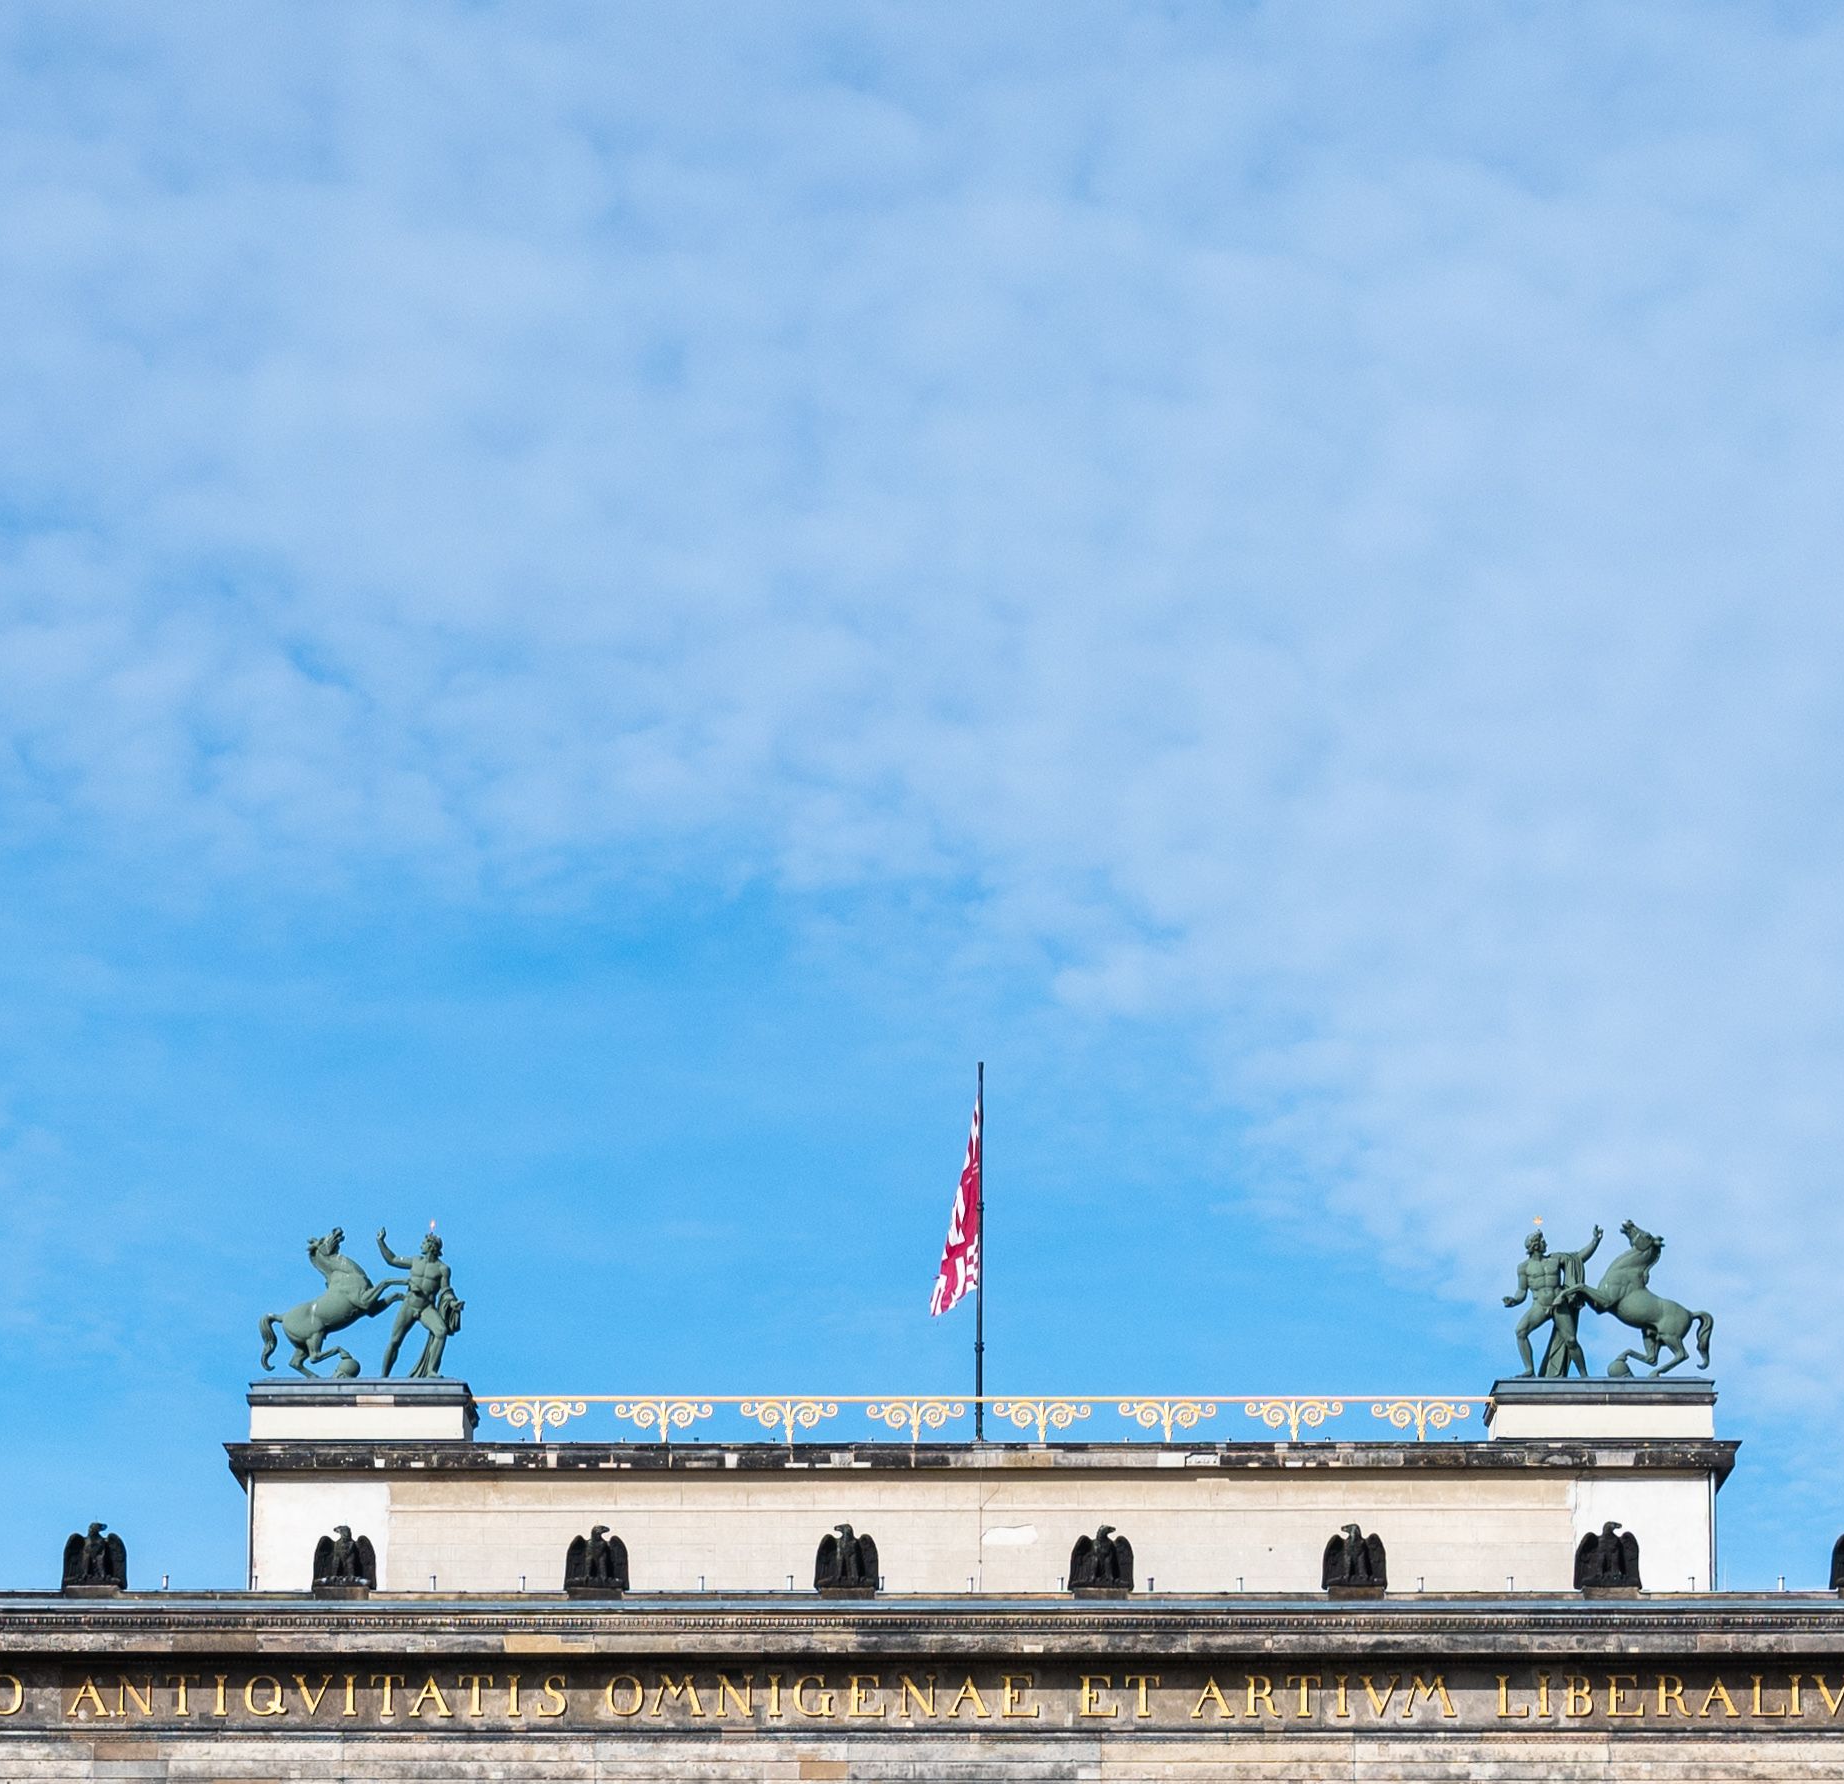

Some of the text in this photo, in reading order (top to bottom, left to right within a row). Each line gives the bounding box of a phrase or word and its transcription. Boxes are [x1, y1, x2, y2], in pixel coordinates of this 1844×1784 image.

[66, 1675, 568, 1717] ANTIQVITATIS
[604, 1675, 1040, 1717] OMNIGENAE
[1078, 1675, 1158, 1717] ET
[1191, 1675, 1456, 1717] ARTIVM
